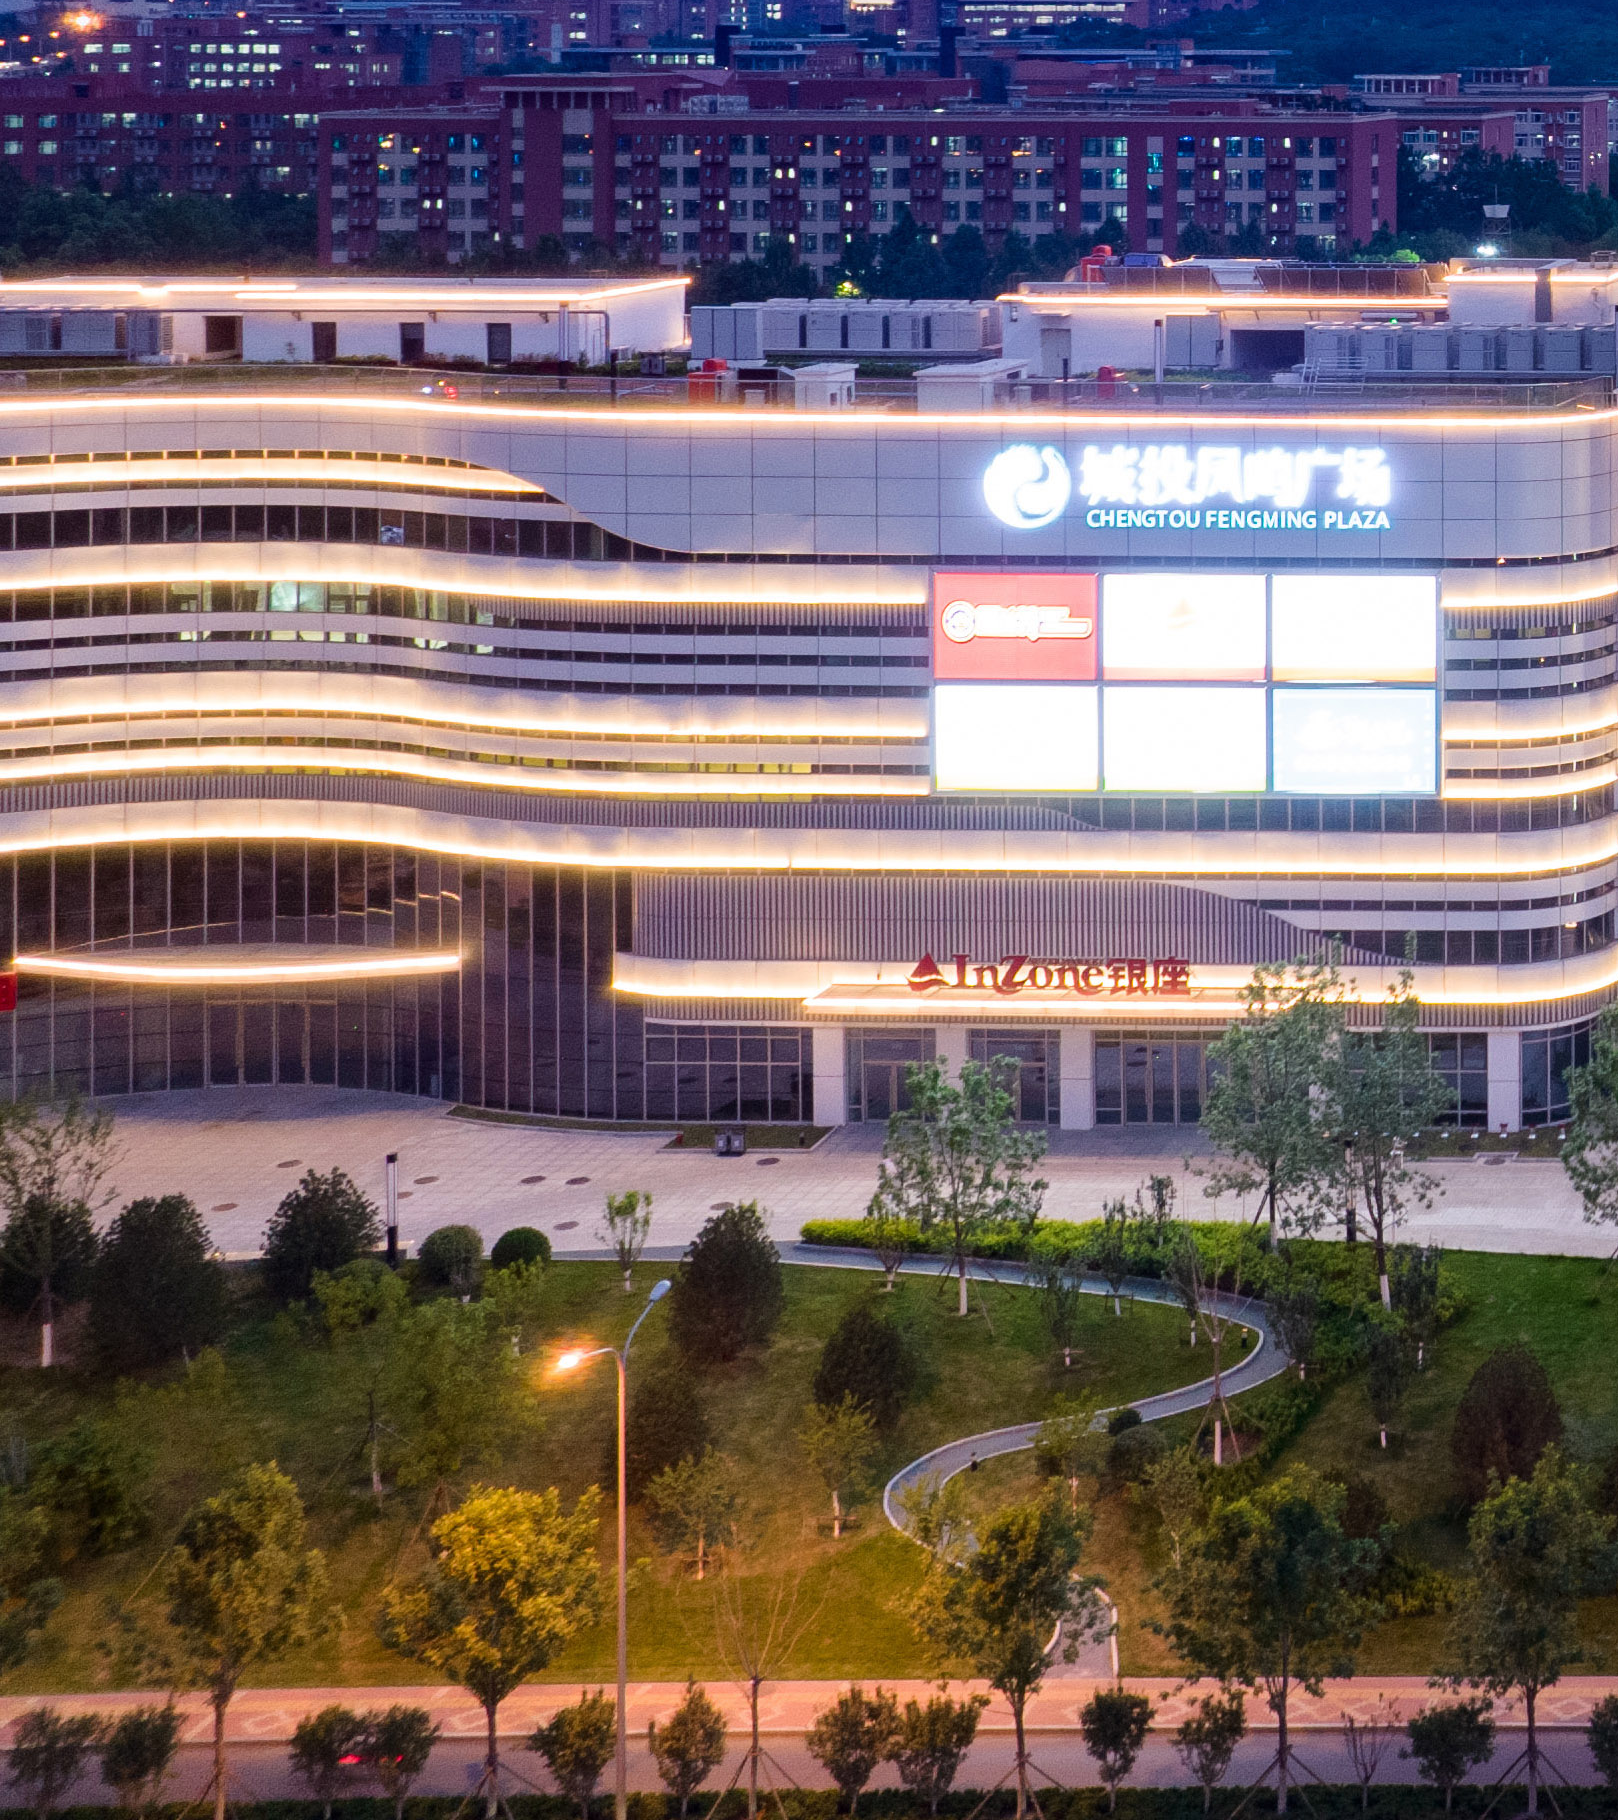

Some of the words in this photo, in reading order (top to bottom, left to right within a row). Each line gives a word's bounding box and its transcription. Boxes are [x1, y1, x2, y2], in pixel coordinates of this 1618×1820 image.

[1086, 508, 1201, 529] CHENGTOU
[1205, 509, 1318, 529] FENGMING
[1324, 510, 1391, 529] PLAZA
